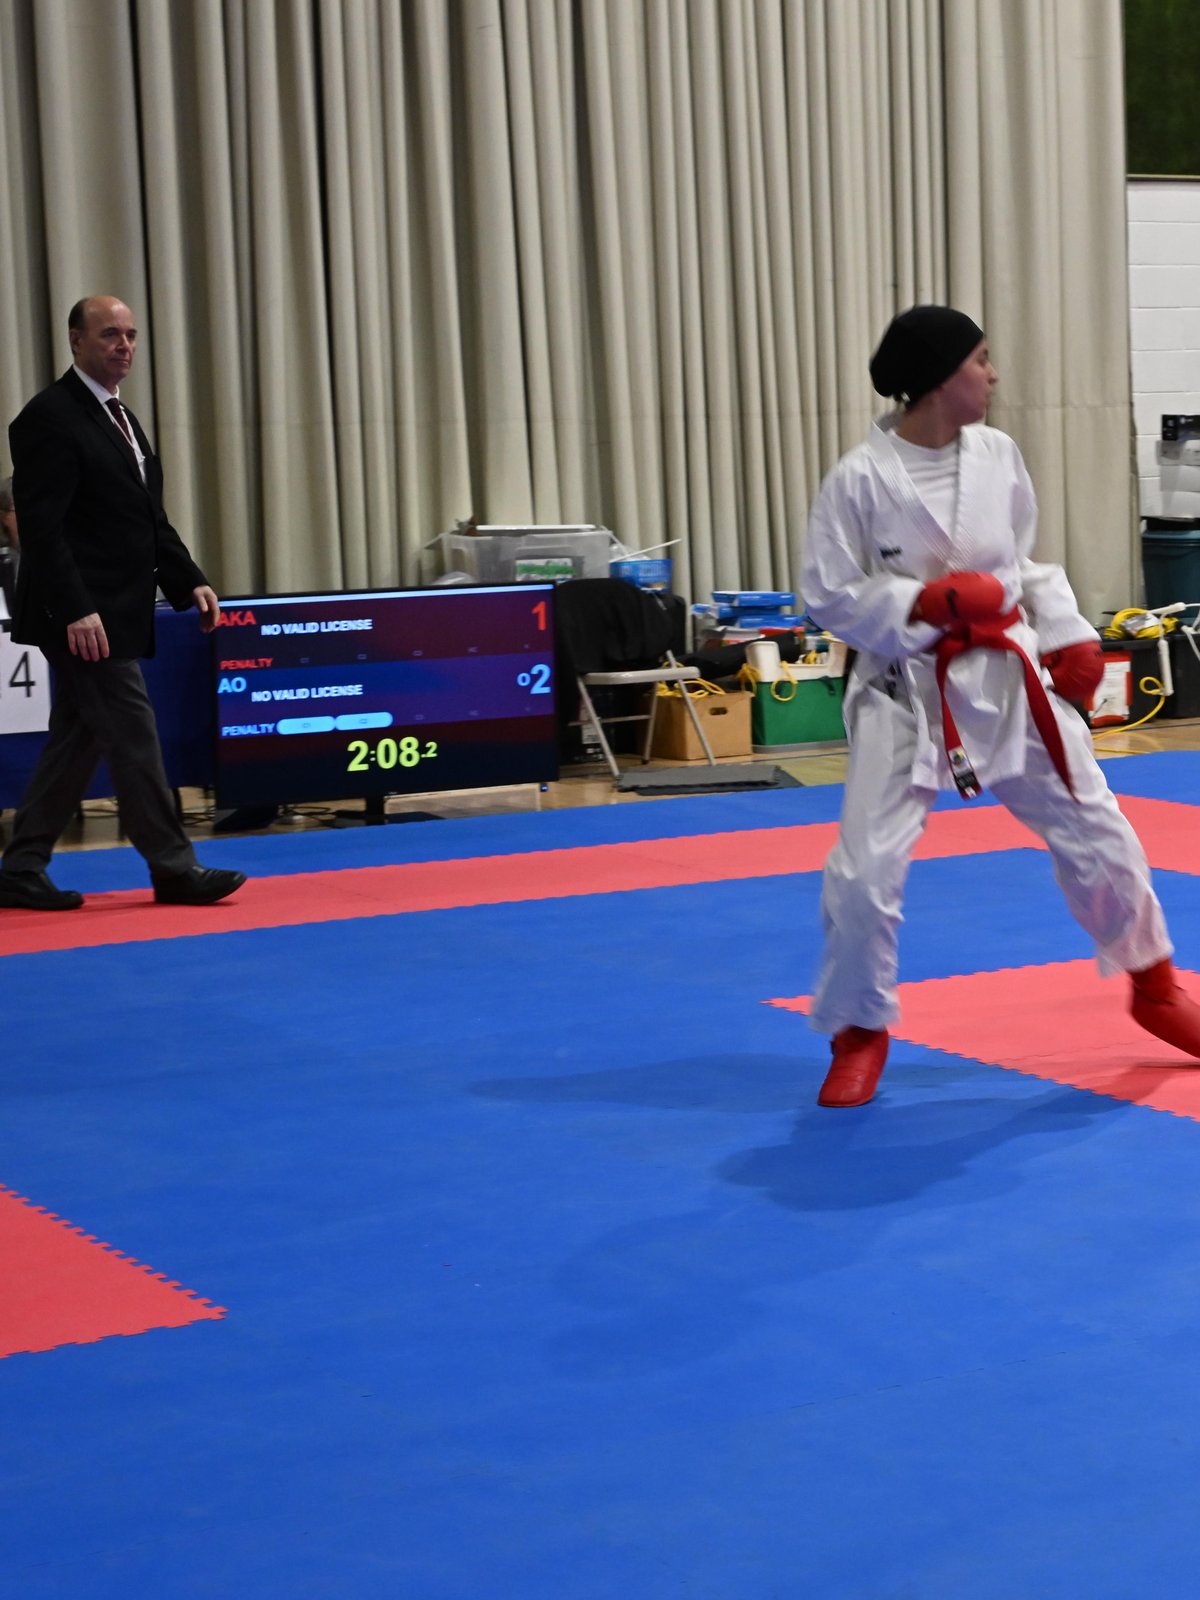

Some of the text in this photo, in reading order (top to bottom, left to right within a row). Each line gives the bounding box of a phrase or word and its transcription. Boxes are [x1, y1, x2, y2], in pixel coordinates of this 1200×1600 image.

[216, 610, 256, 627] AKA
[531, 601, 547, 631] 1
[261, 619, 373, 636] NO VALID LICENSE
[220, 658, 273, 670] PENALTY
[8, 651, 36, 698] 4
[217, 677, 247, 694] AO
[251, 684, 363, 702] NO VALID LICENSE
[222, 723, 275, 737] PENALTY
